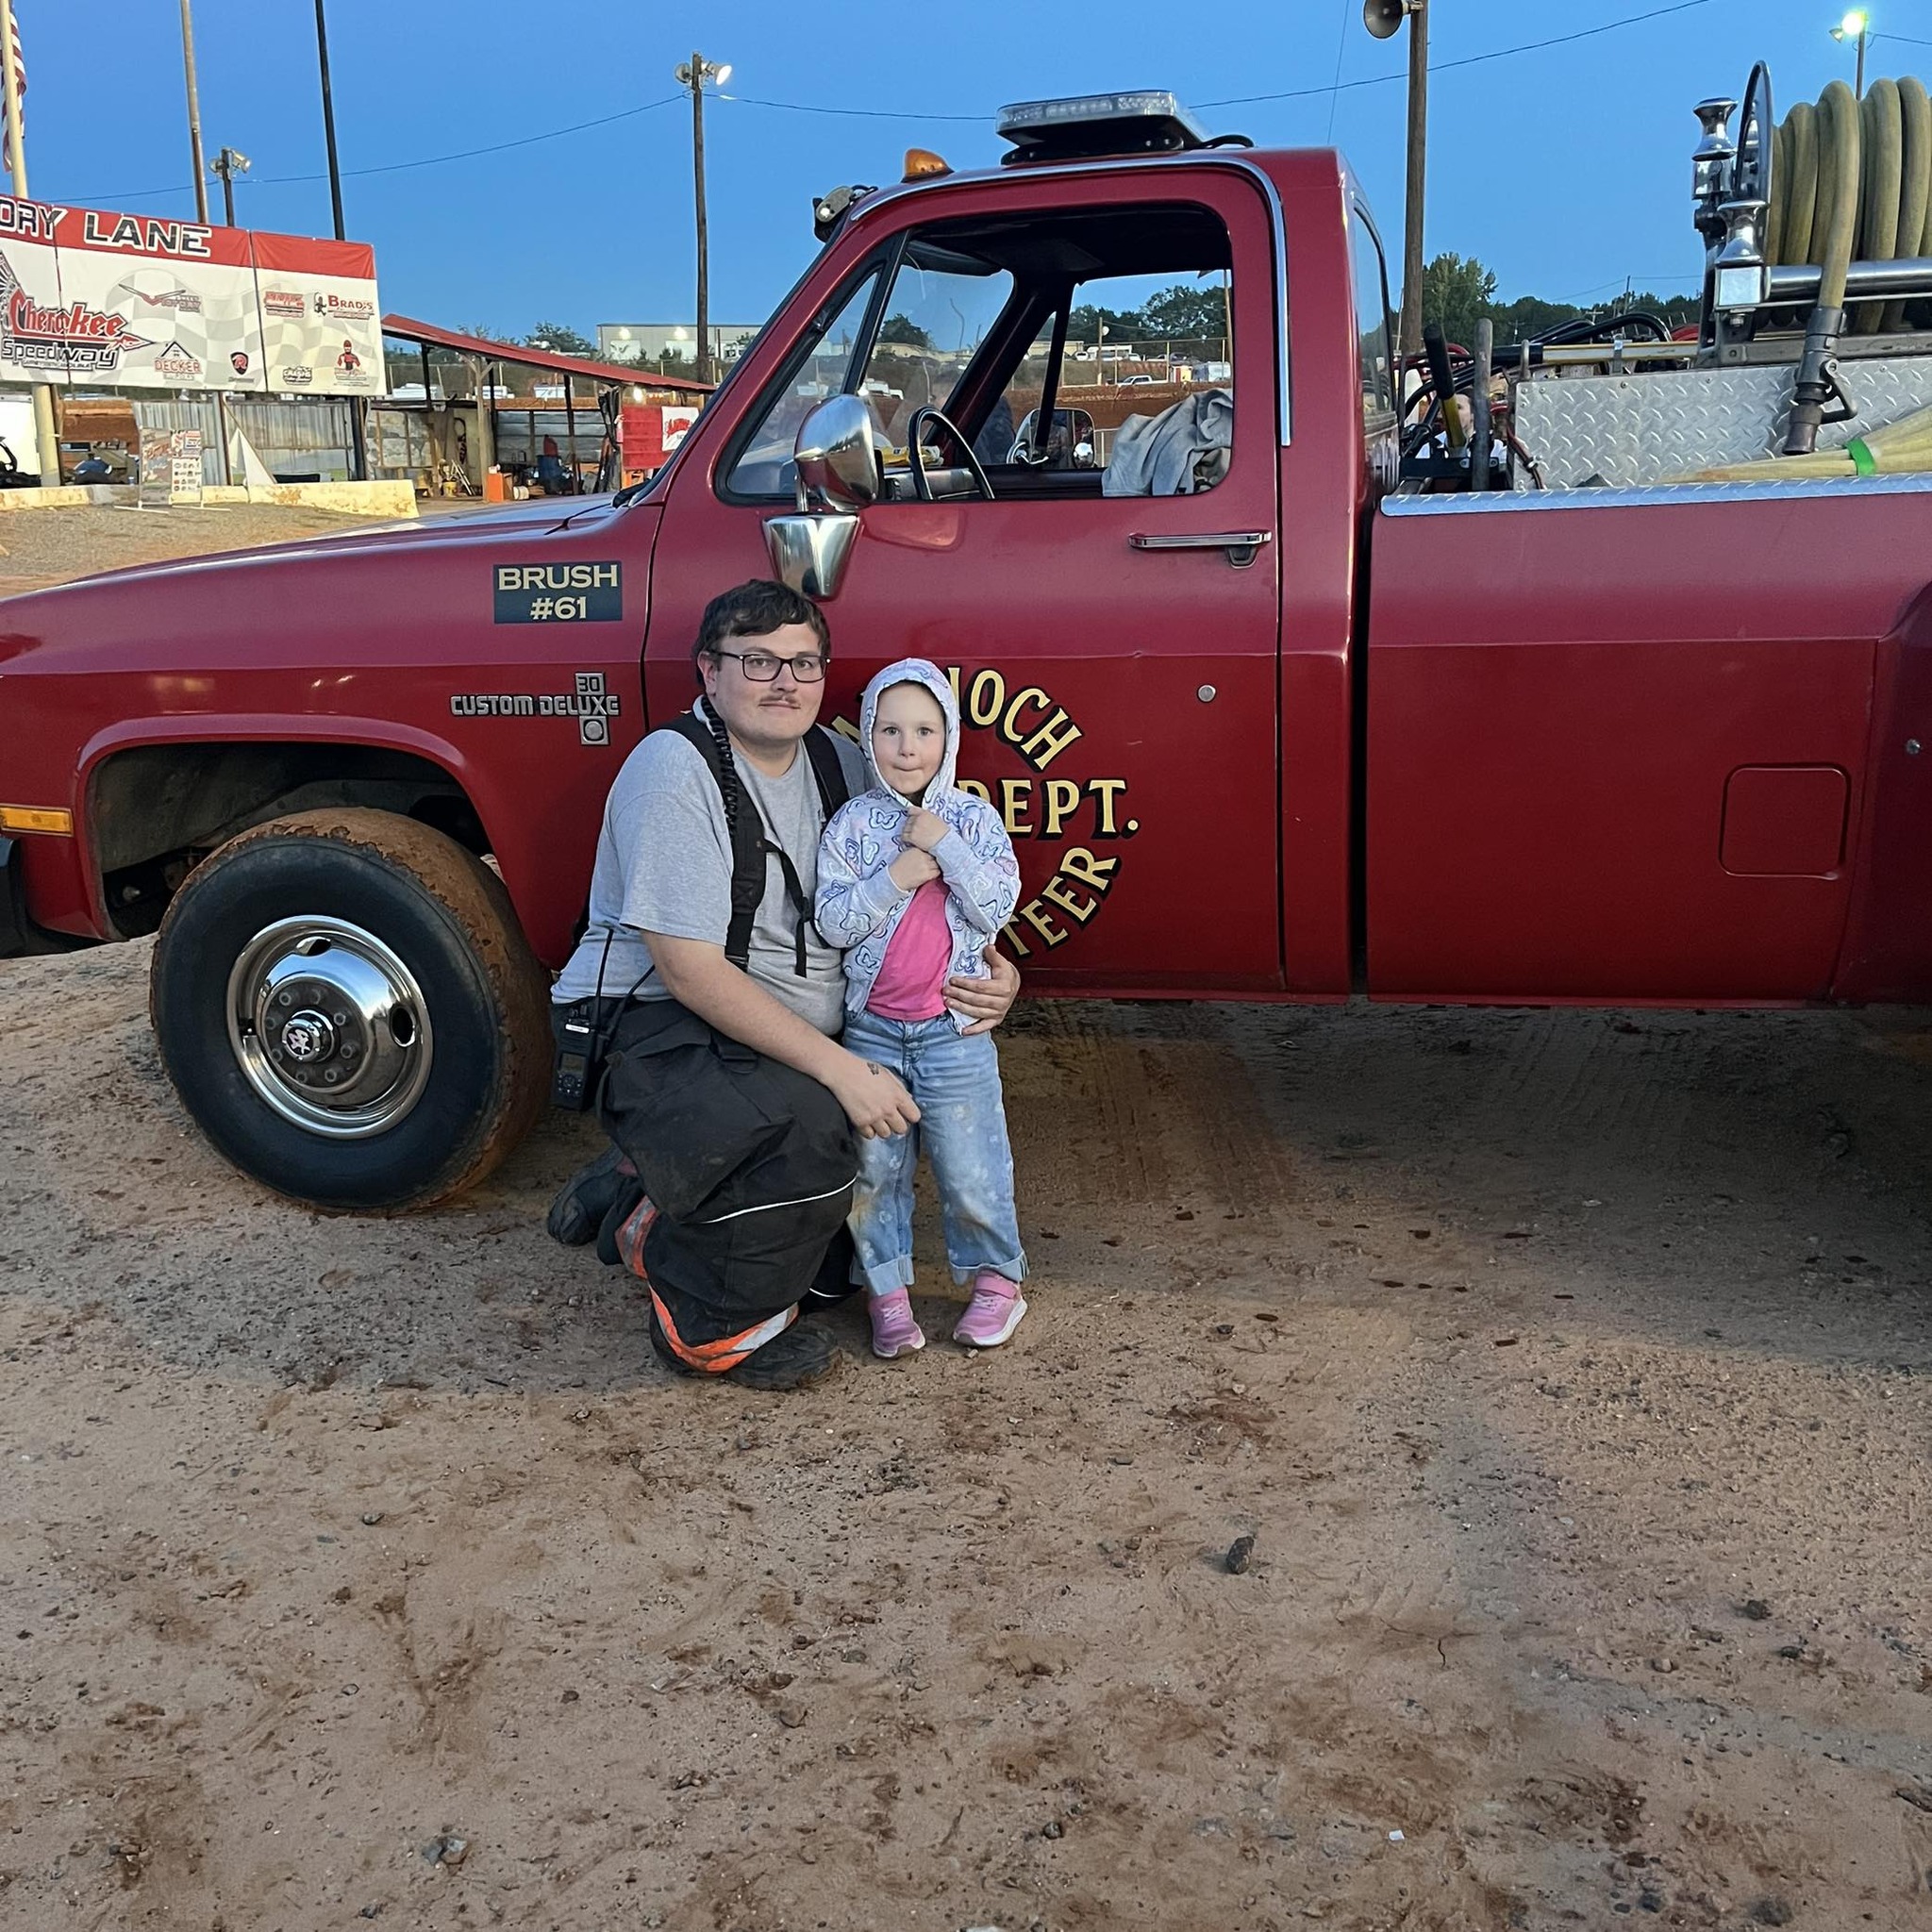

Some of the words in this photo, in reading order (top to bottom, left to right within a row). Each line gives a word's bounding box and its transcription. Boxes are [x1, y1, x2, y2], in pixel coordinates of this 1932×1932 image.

[84, 212, 211, 258] LANE
[9, 289, 127, 337] Cherokee
[2, 337, 119, 370] Speedway
[155, 359, 201, 374] DECKER
[498, 564, 618, 591] BRUSH
[530, 596, 587, 620] #61
[577, 675, 600, 692] 30
[450, 695, 535, 716] CUSTOM
[539, 695, 620, 716] DELUXE
